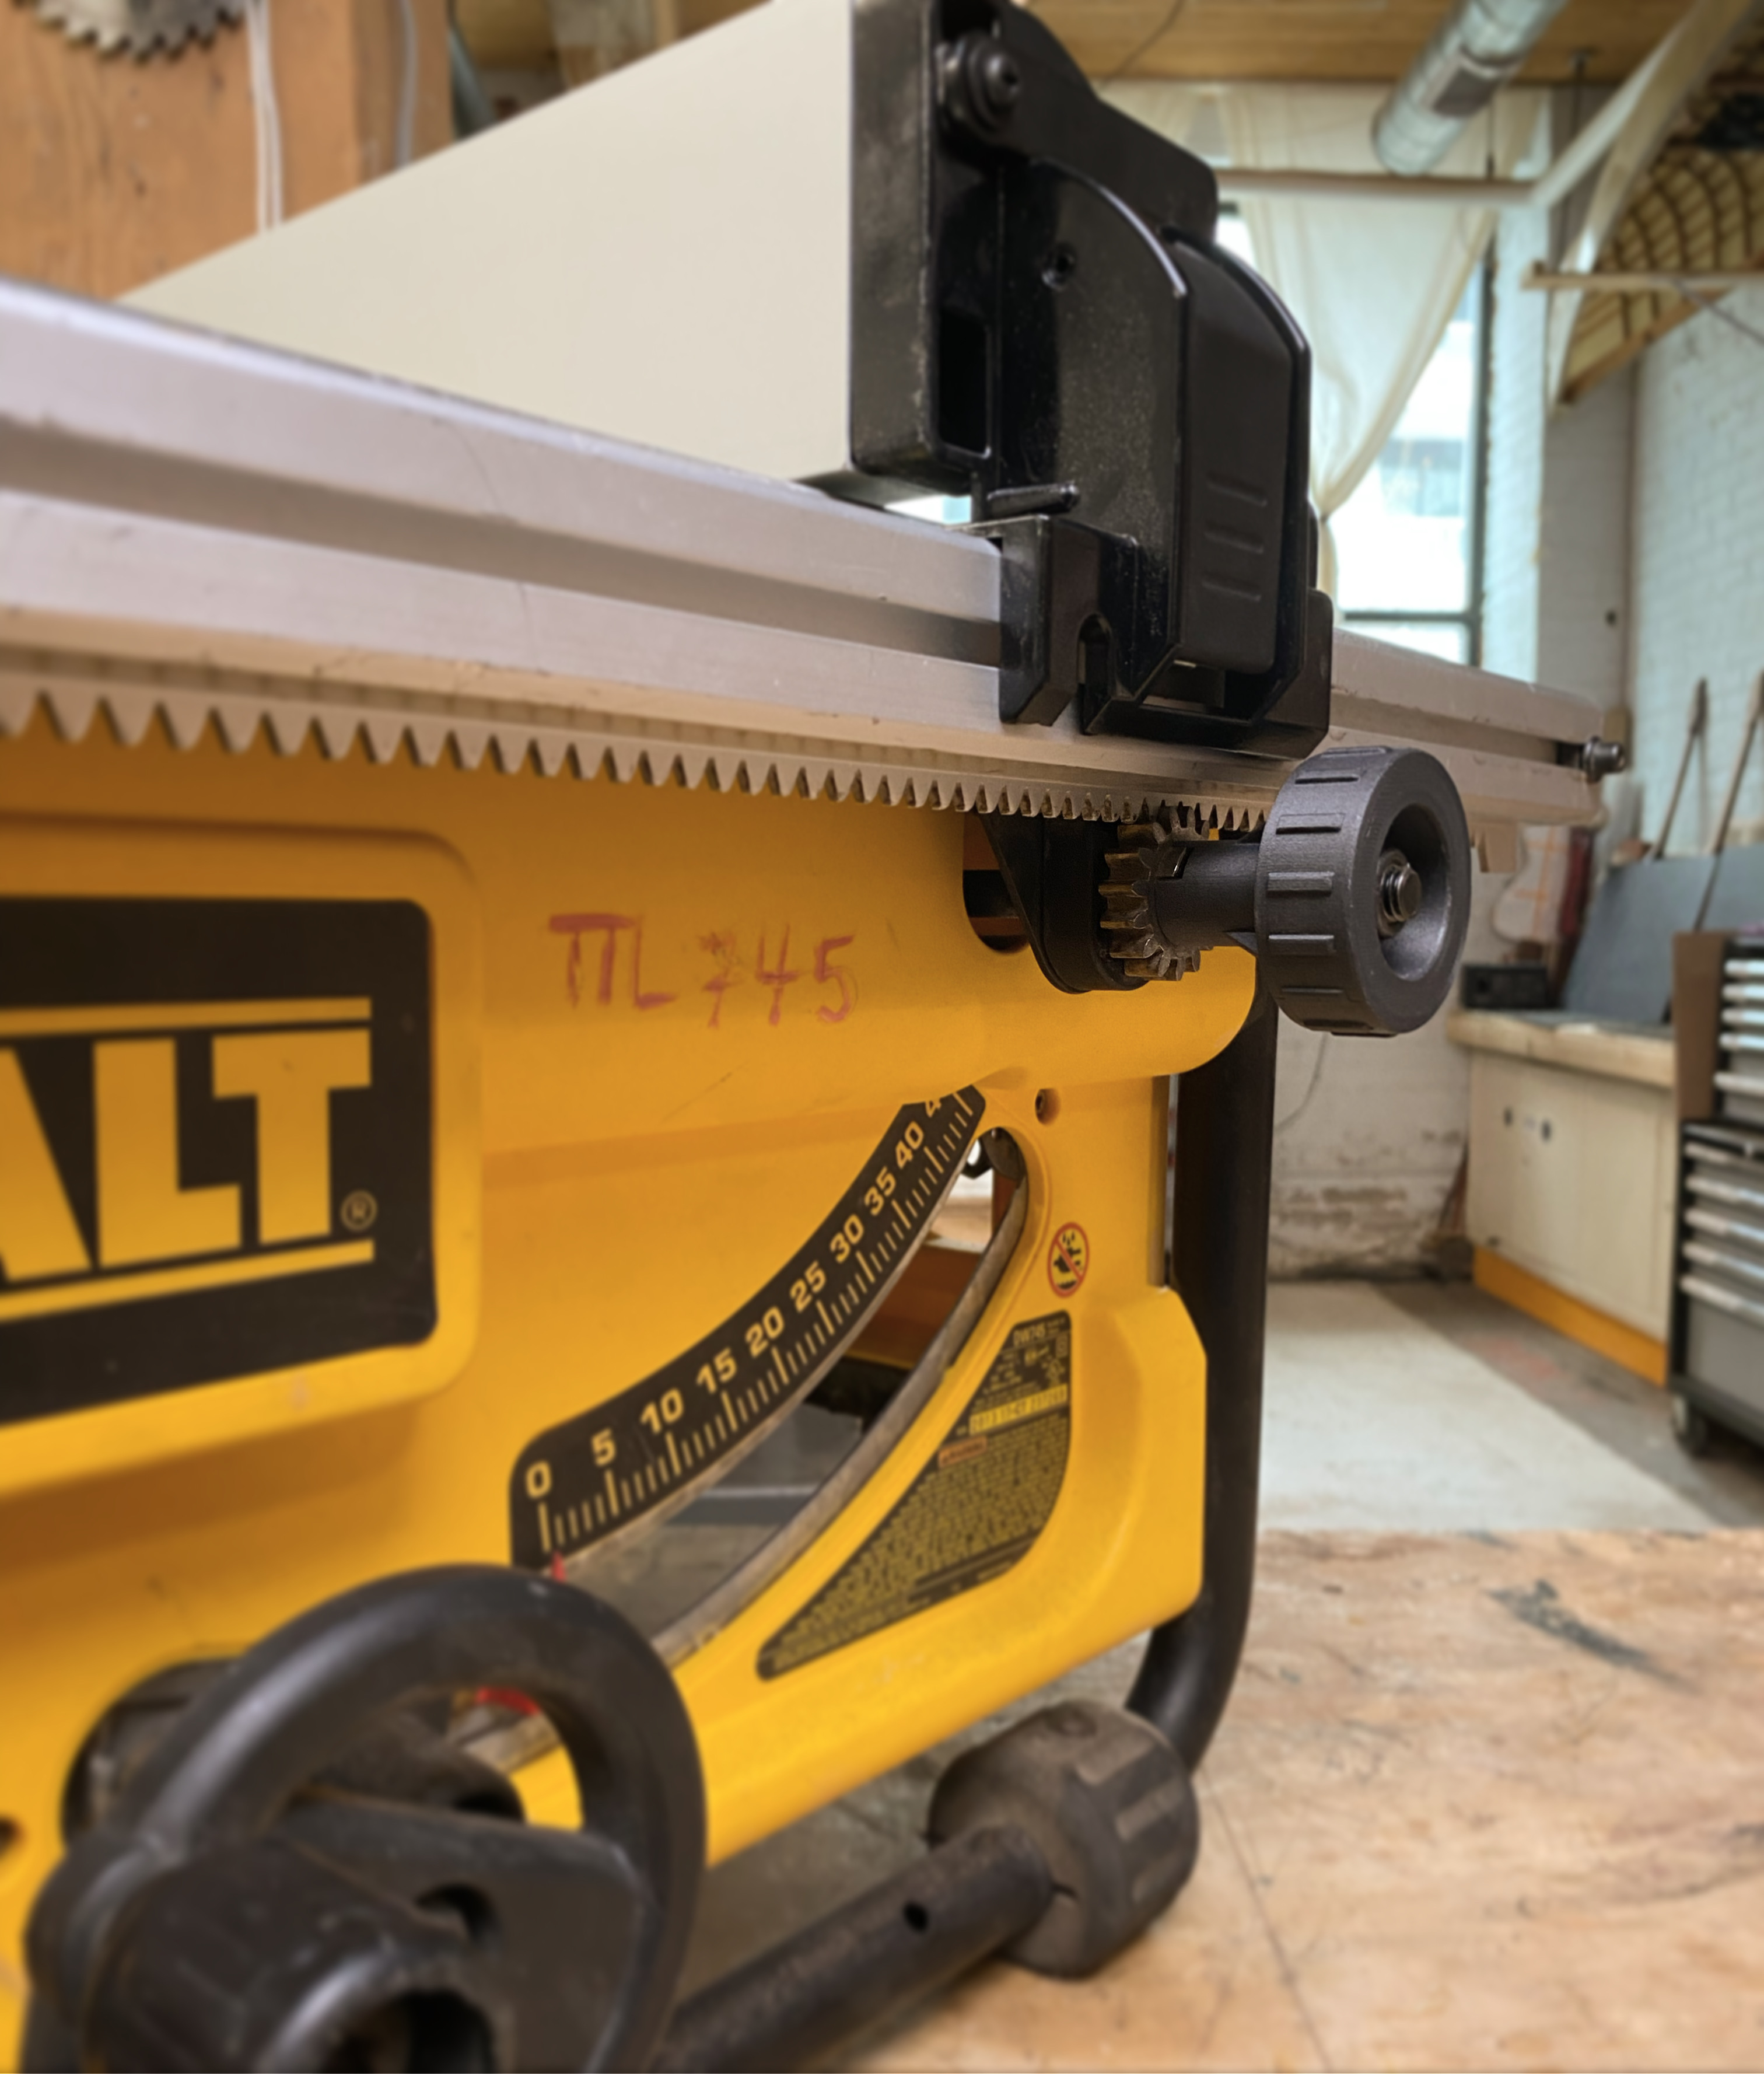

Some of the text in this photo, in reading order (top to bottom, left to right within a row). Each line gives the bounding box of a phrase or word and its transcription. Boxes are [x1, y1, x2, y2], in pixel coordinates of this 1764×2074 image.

[699, 923, 856, 1029] 745
[526, 1461, 551, 1498] 0
[592, 1429, 616, 1466] 5
[640, 1389, 684, 1434] 10
[696, 1349, 737, 1394] 15
[745, 1306, 785, 1356] 20
[790, 1261, 827, 1312] 25
[830, 1214, 865, 1263] 30
[863, 1166, 897, 1215] 35
[896, 1120, 924, 1169] 40
